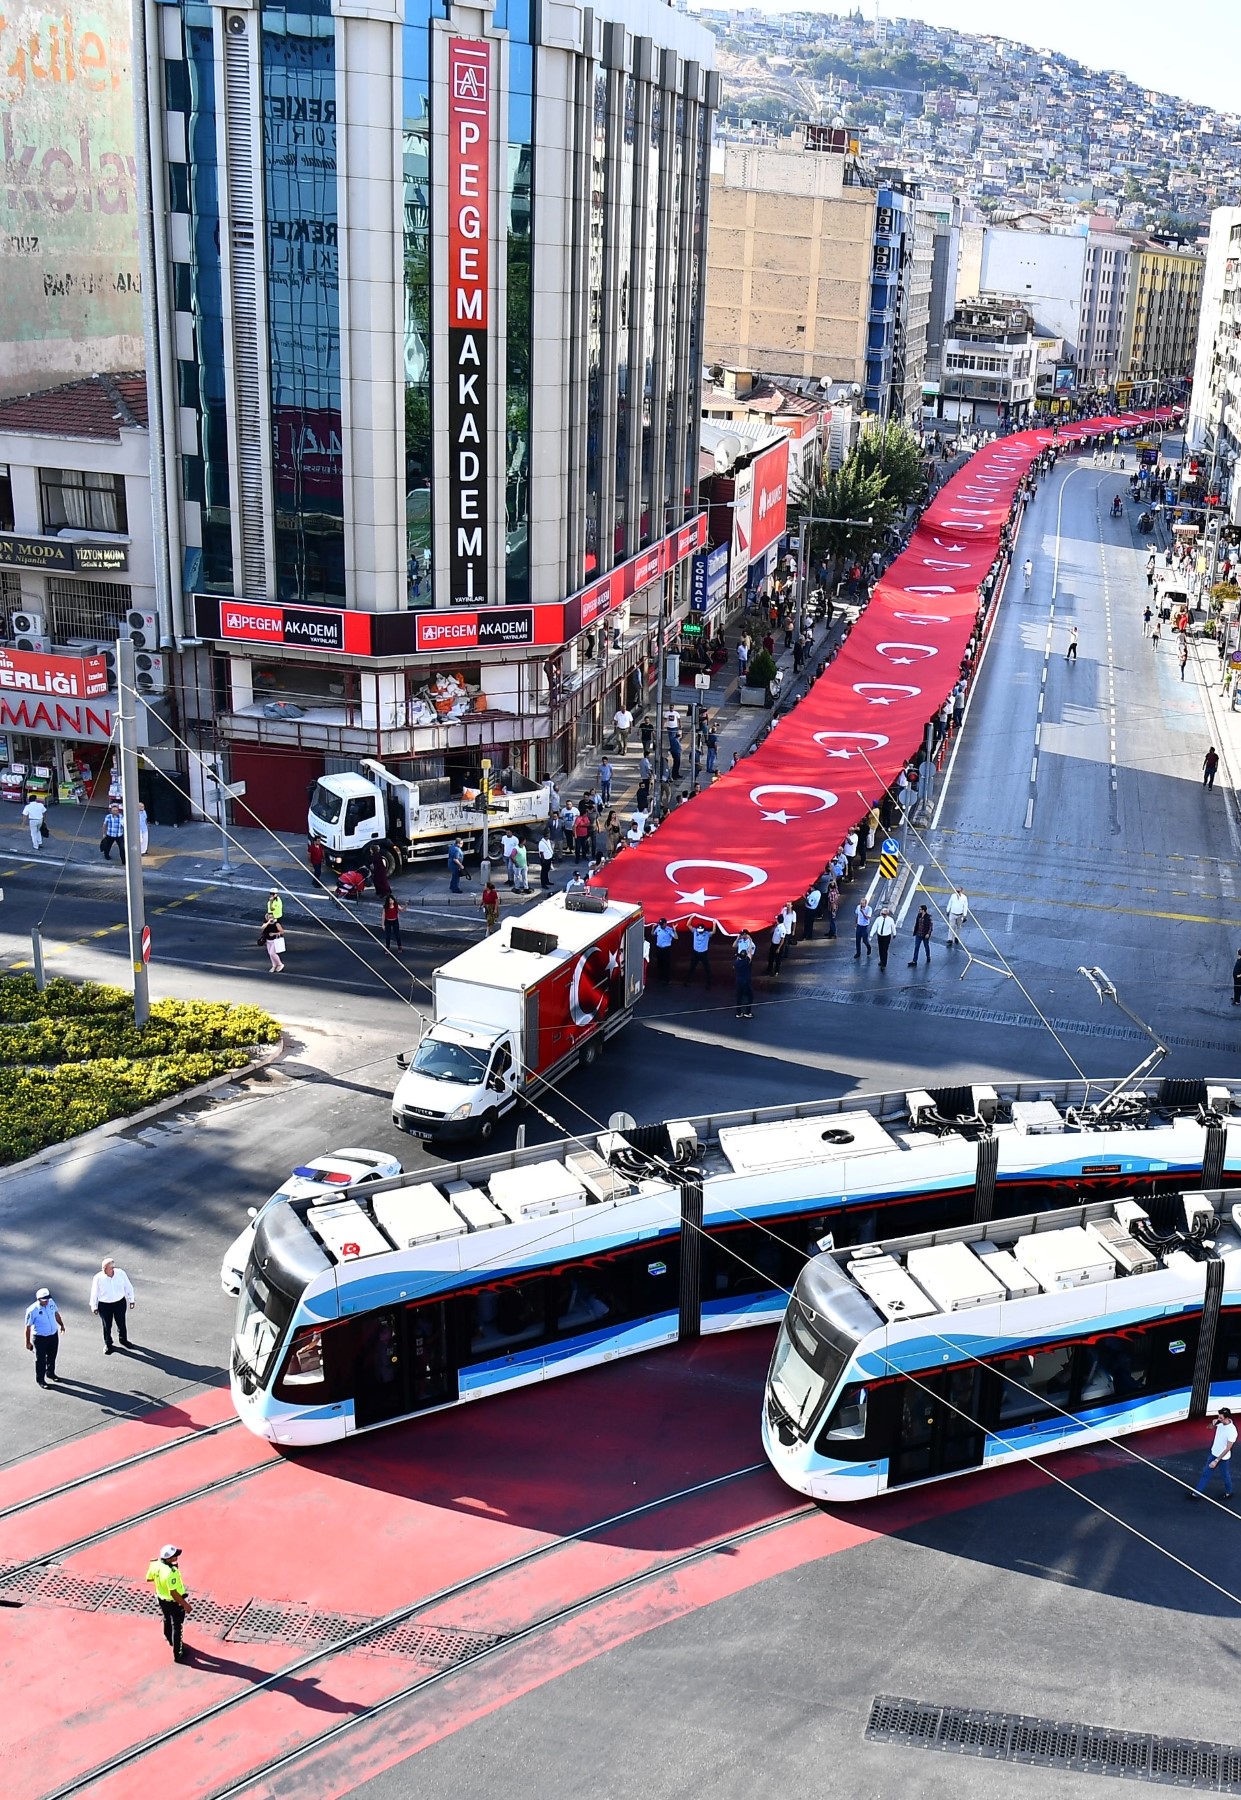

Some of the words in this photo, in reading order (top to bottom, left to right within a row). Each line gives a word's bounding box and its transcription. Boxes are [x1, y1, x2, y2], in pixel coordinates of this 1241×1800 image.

[457, 121, 482, 321] PEGEM
[457, 334, 482, 597] AKADEMİ
[15, 555, 47, 565] Nişanlık
[18, 543, 65, 559] MODA
[75, 548, 102, 560] VİZYON
[103, 549, 125, 560] MODA
[242, 616, 282, 632] PEGEM
[284, 621, 338, 638] AKADEMİ
[437, 624, 477, 638] PEGEM
[479, 618, 528, 635] AKADEMİ
[0, 697, 111, 737] MANN
